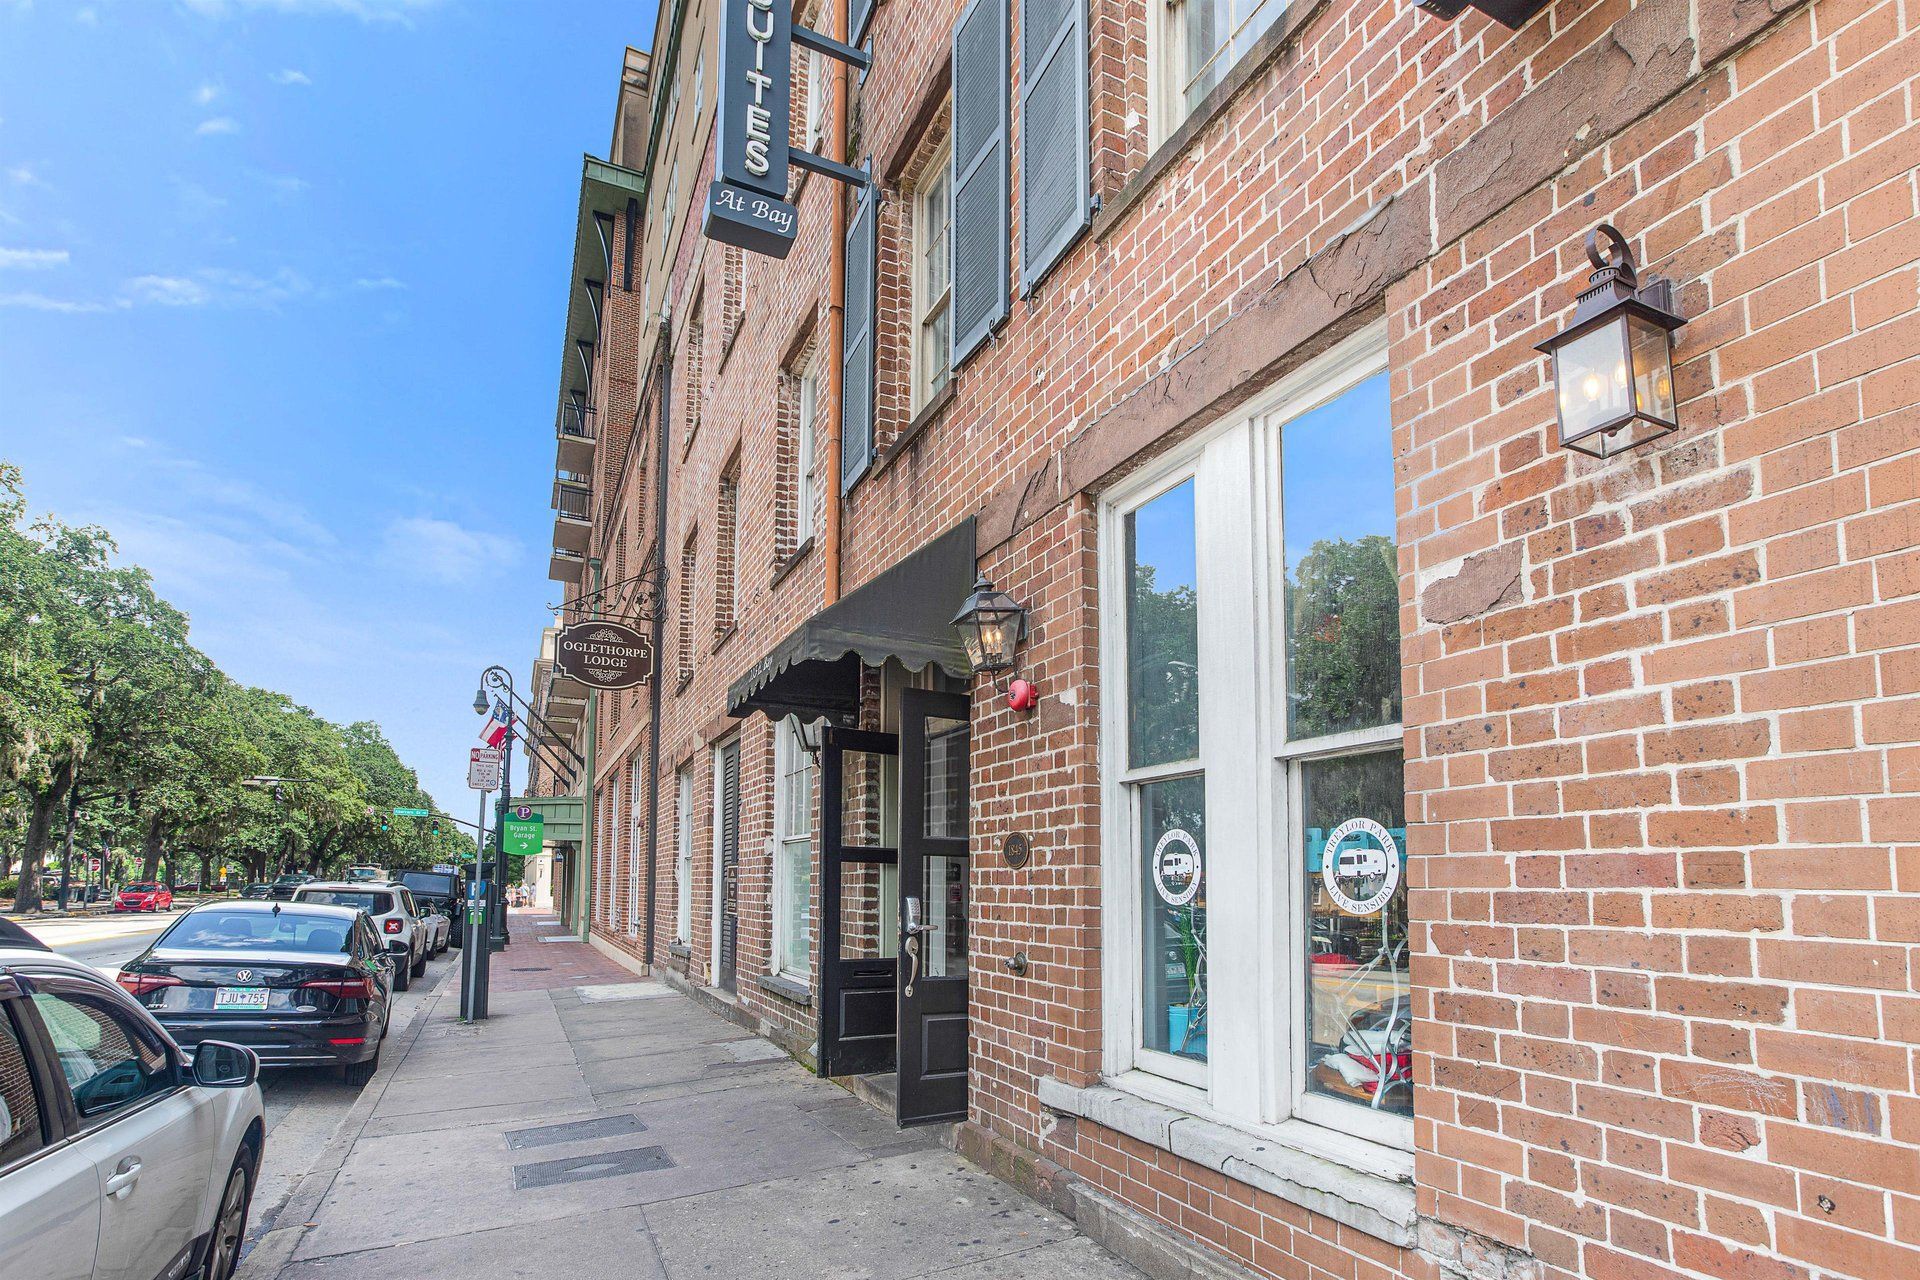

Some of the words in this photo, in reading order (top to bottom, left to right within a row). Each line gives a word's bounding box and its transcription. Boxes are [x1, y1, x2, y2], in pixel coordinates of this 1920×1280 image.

[744, 0, 775, 177] UITES
[715, 189, 746, 212] At
[752, 199, 793, 233] Bay
[563, 641, 648, 659] OGLETHORPE
[584, 655, 628, 668] LODGE
[472, 750, 480, 760] NO
[521, 807, 530, 817] P
[1155, 831, 1180, 857] TREYLOR
[1182, 834, 1199, 857] PARK
[1326, 820, 1365, 854] TREYLOR
[1369, 823, 1395, 853] PARK
[1157, 882, 1170, 900] LIVE
[1171, 882, 1197, 904] SENSIBLY
[1329, 885, 1349, 909] LIVE
[1351, 884, 1393, 912] SENSIBLY
[221, 993, 239, 1003] TJU
[248, 993, 266, 1003] 755
